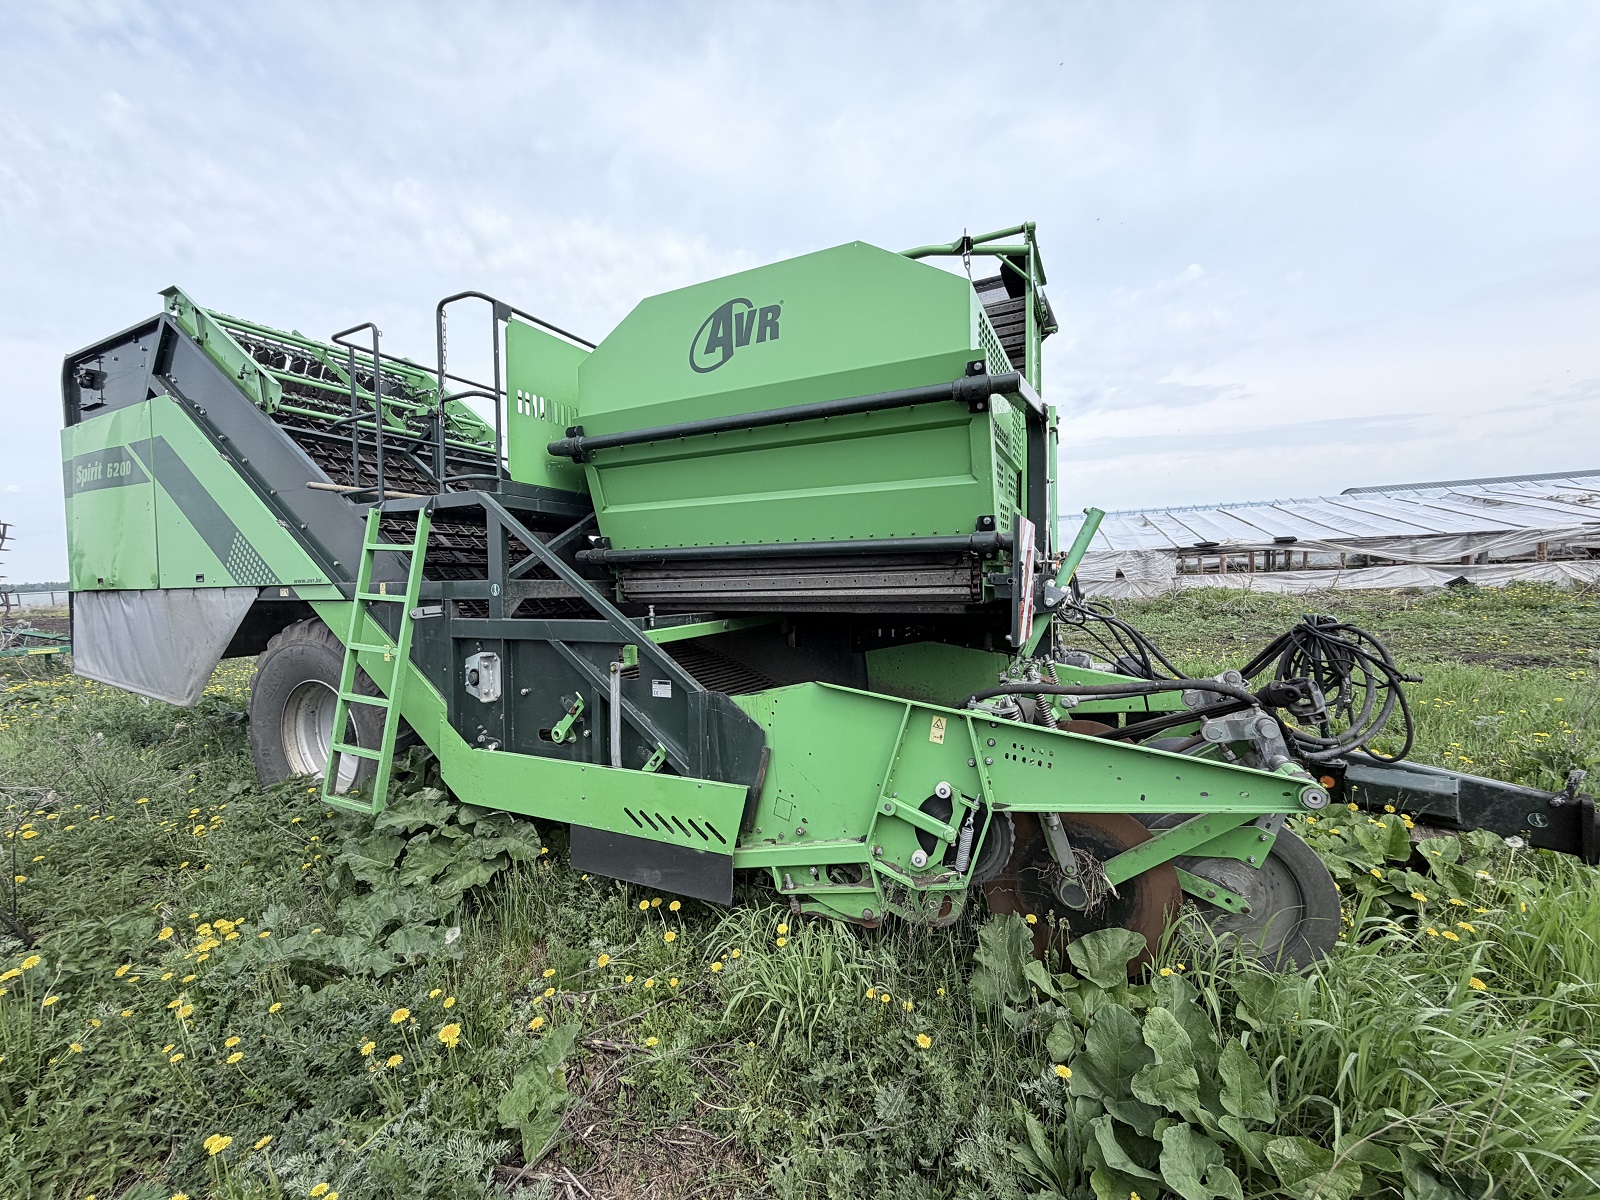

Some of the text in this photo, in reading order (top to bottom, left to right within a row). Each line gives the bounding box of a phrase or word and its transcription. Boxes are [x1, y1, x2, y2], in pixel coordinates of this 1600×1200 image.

[689, 298, 781, 374] AVR
[76, 460, 131, 487] Spirit 6200
